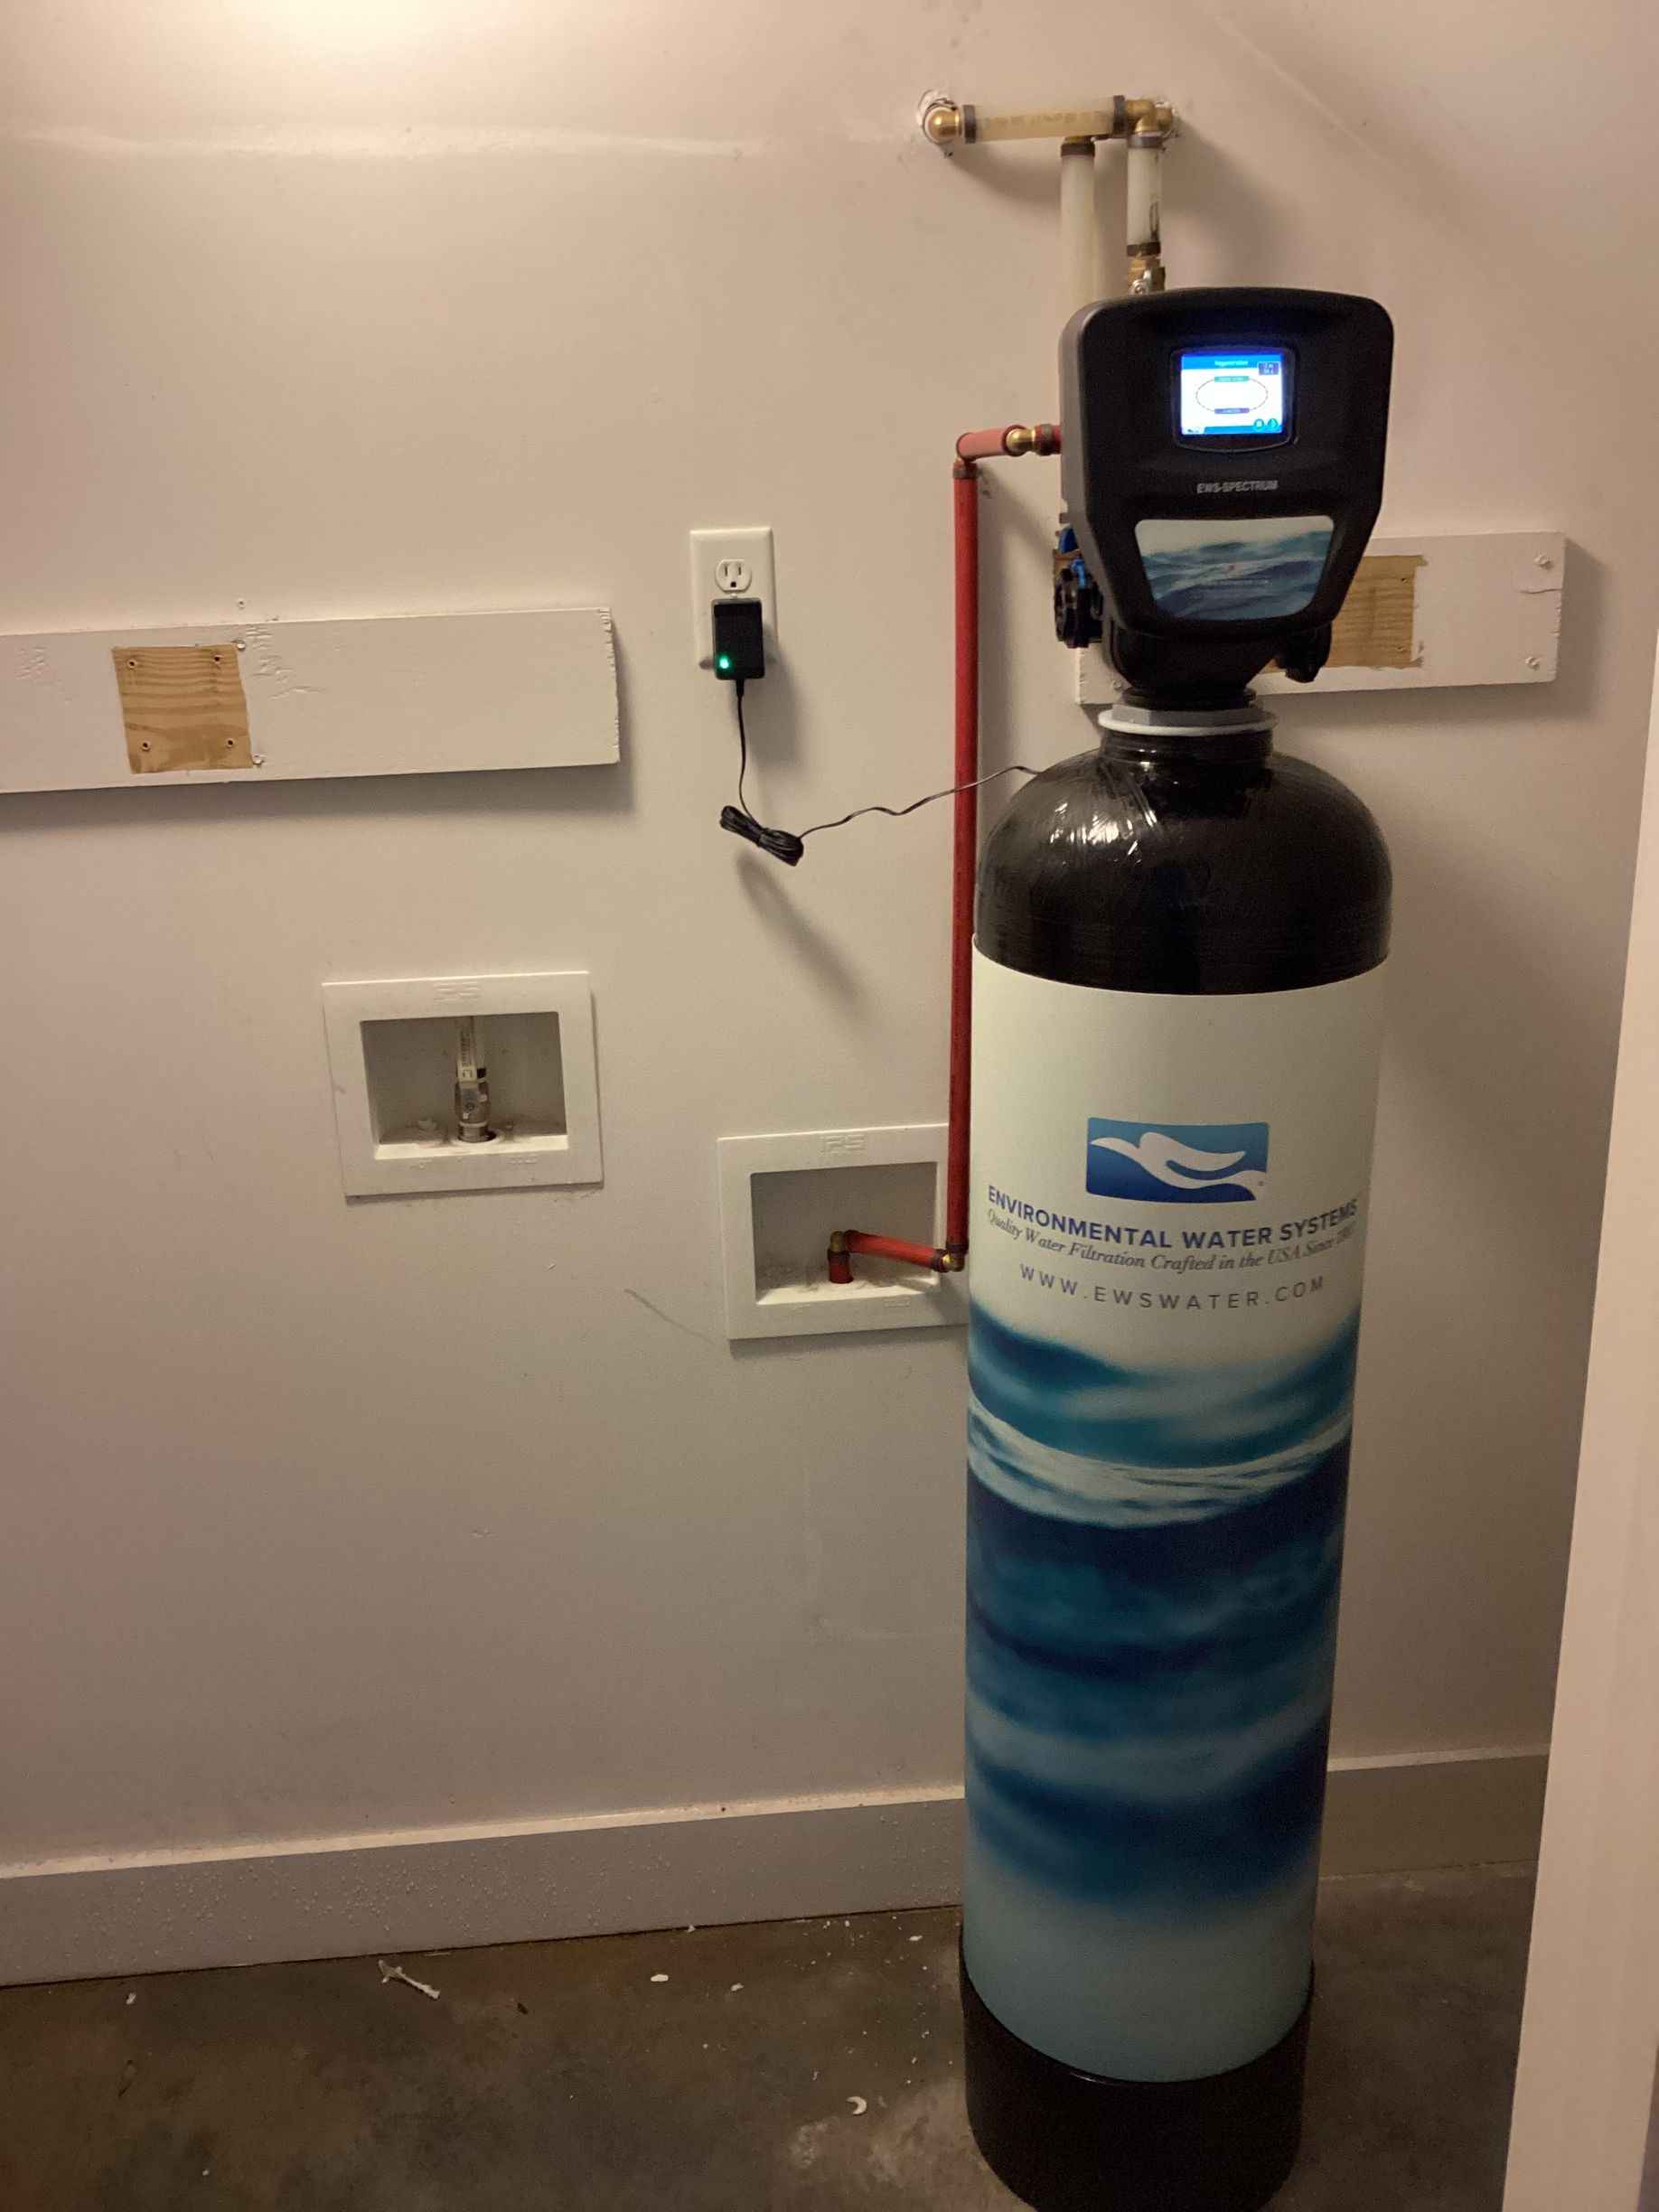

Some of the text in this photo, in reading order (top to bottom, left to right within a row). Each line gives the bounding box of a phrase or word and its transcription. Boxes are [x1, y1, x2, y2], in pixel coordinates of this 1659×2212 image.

[988, 1209, 1023, 1241] Quality
[1026, 1228, 1066, 1252] Water
[1069, 1242, 1145, 1268] Filtration
[1151, 1254, 1216, 1274] Crafted
[1219, 1255, 1234, 1270] in
[1240, 1252, 1264, 1268] the
[989, 1185, 1172, 1248] ENVIRONMENTAL
[1182, 1227, 1272, 1249] WATER
[1279, 1198, 1357, 1242] SYSTEMS
[1020, 1264, 1324, 1309] WWW.EWSWATER.COM
